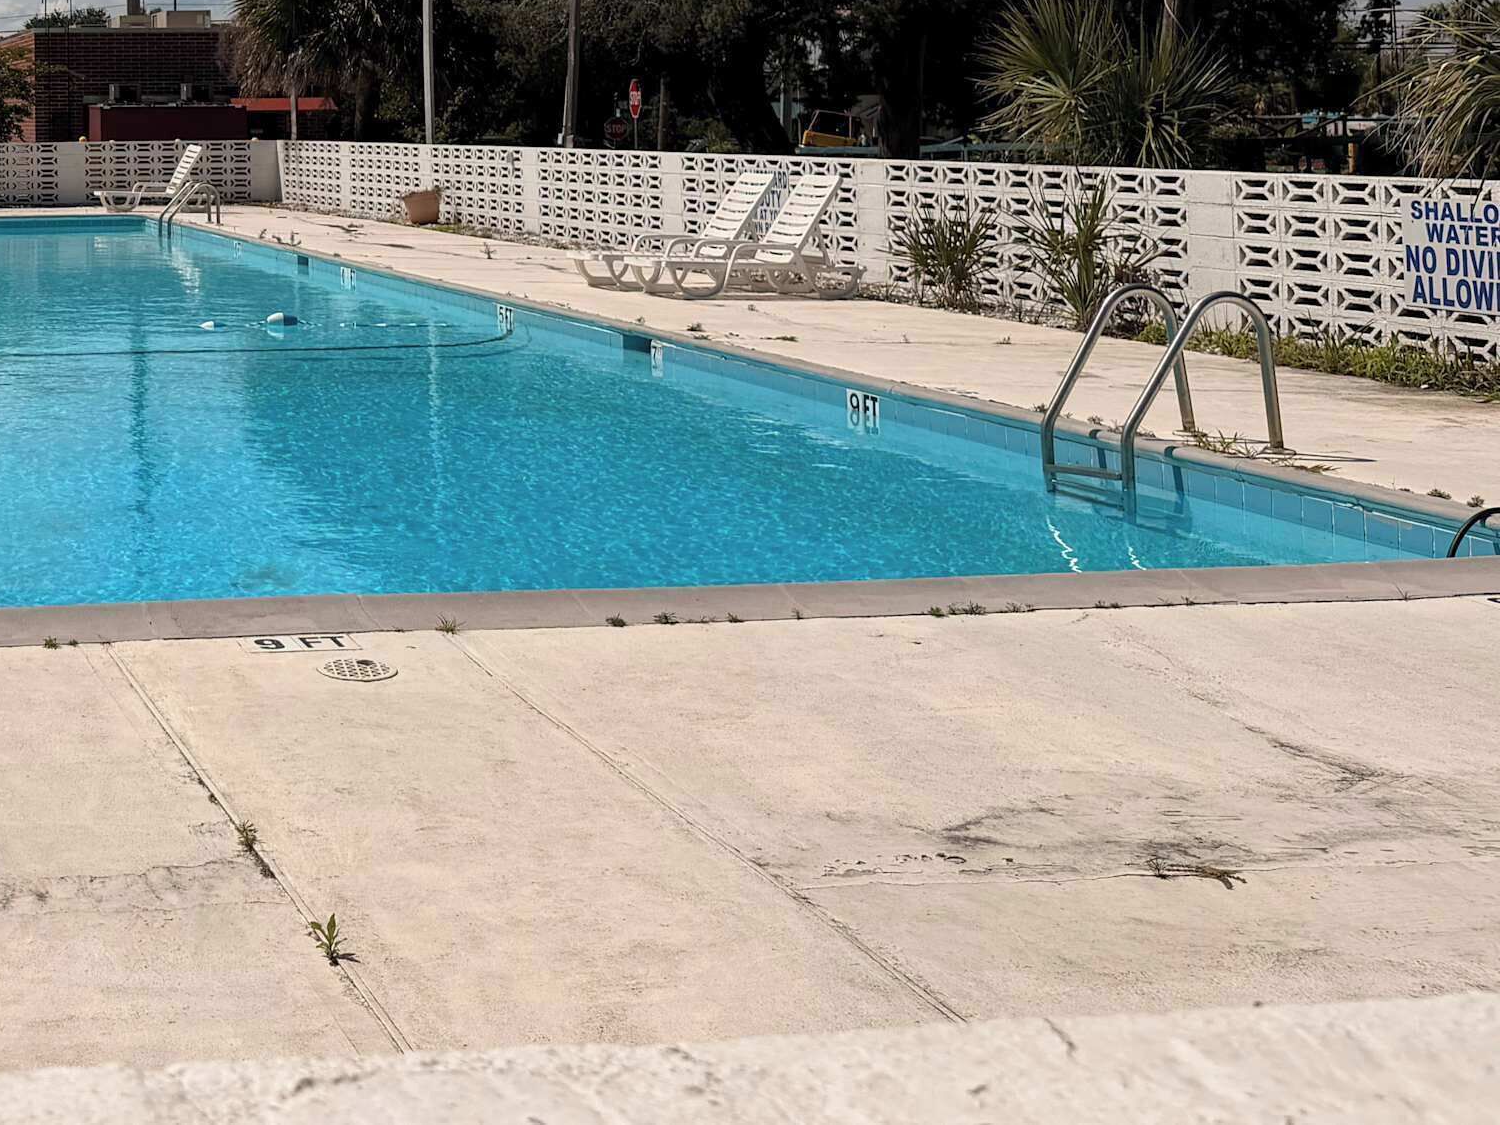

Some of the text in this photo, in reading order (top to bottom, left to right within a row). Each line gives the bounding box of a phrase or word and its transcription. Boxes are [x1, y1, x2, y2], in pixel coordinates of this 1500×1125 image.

[1411, 200, 1500, 224] SHALLO
[1406, 245, 1500, 280] NO DIVI
[1412, 275, 1500, 311] ALLOW
[850, 393, 878, 417] 9 FT
[254, 635, 345, 650] 9 FT
